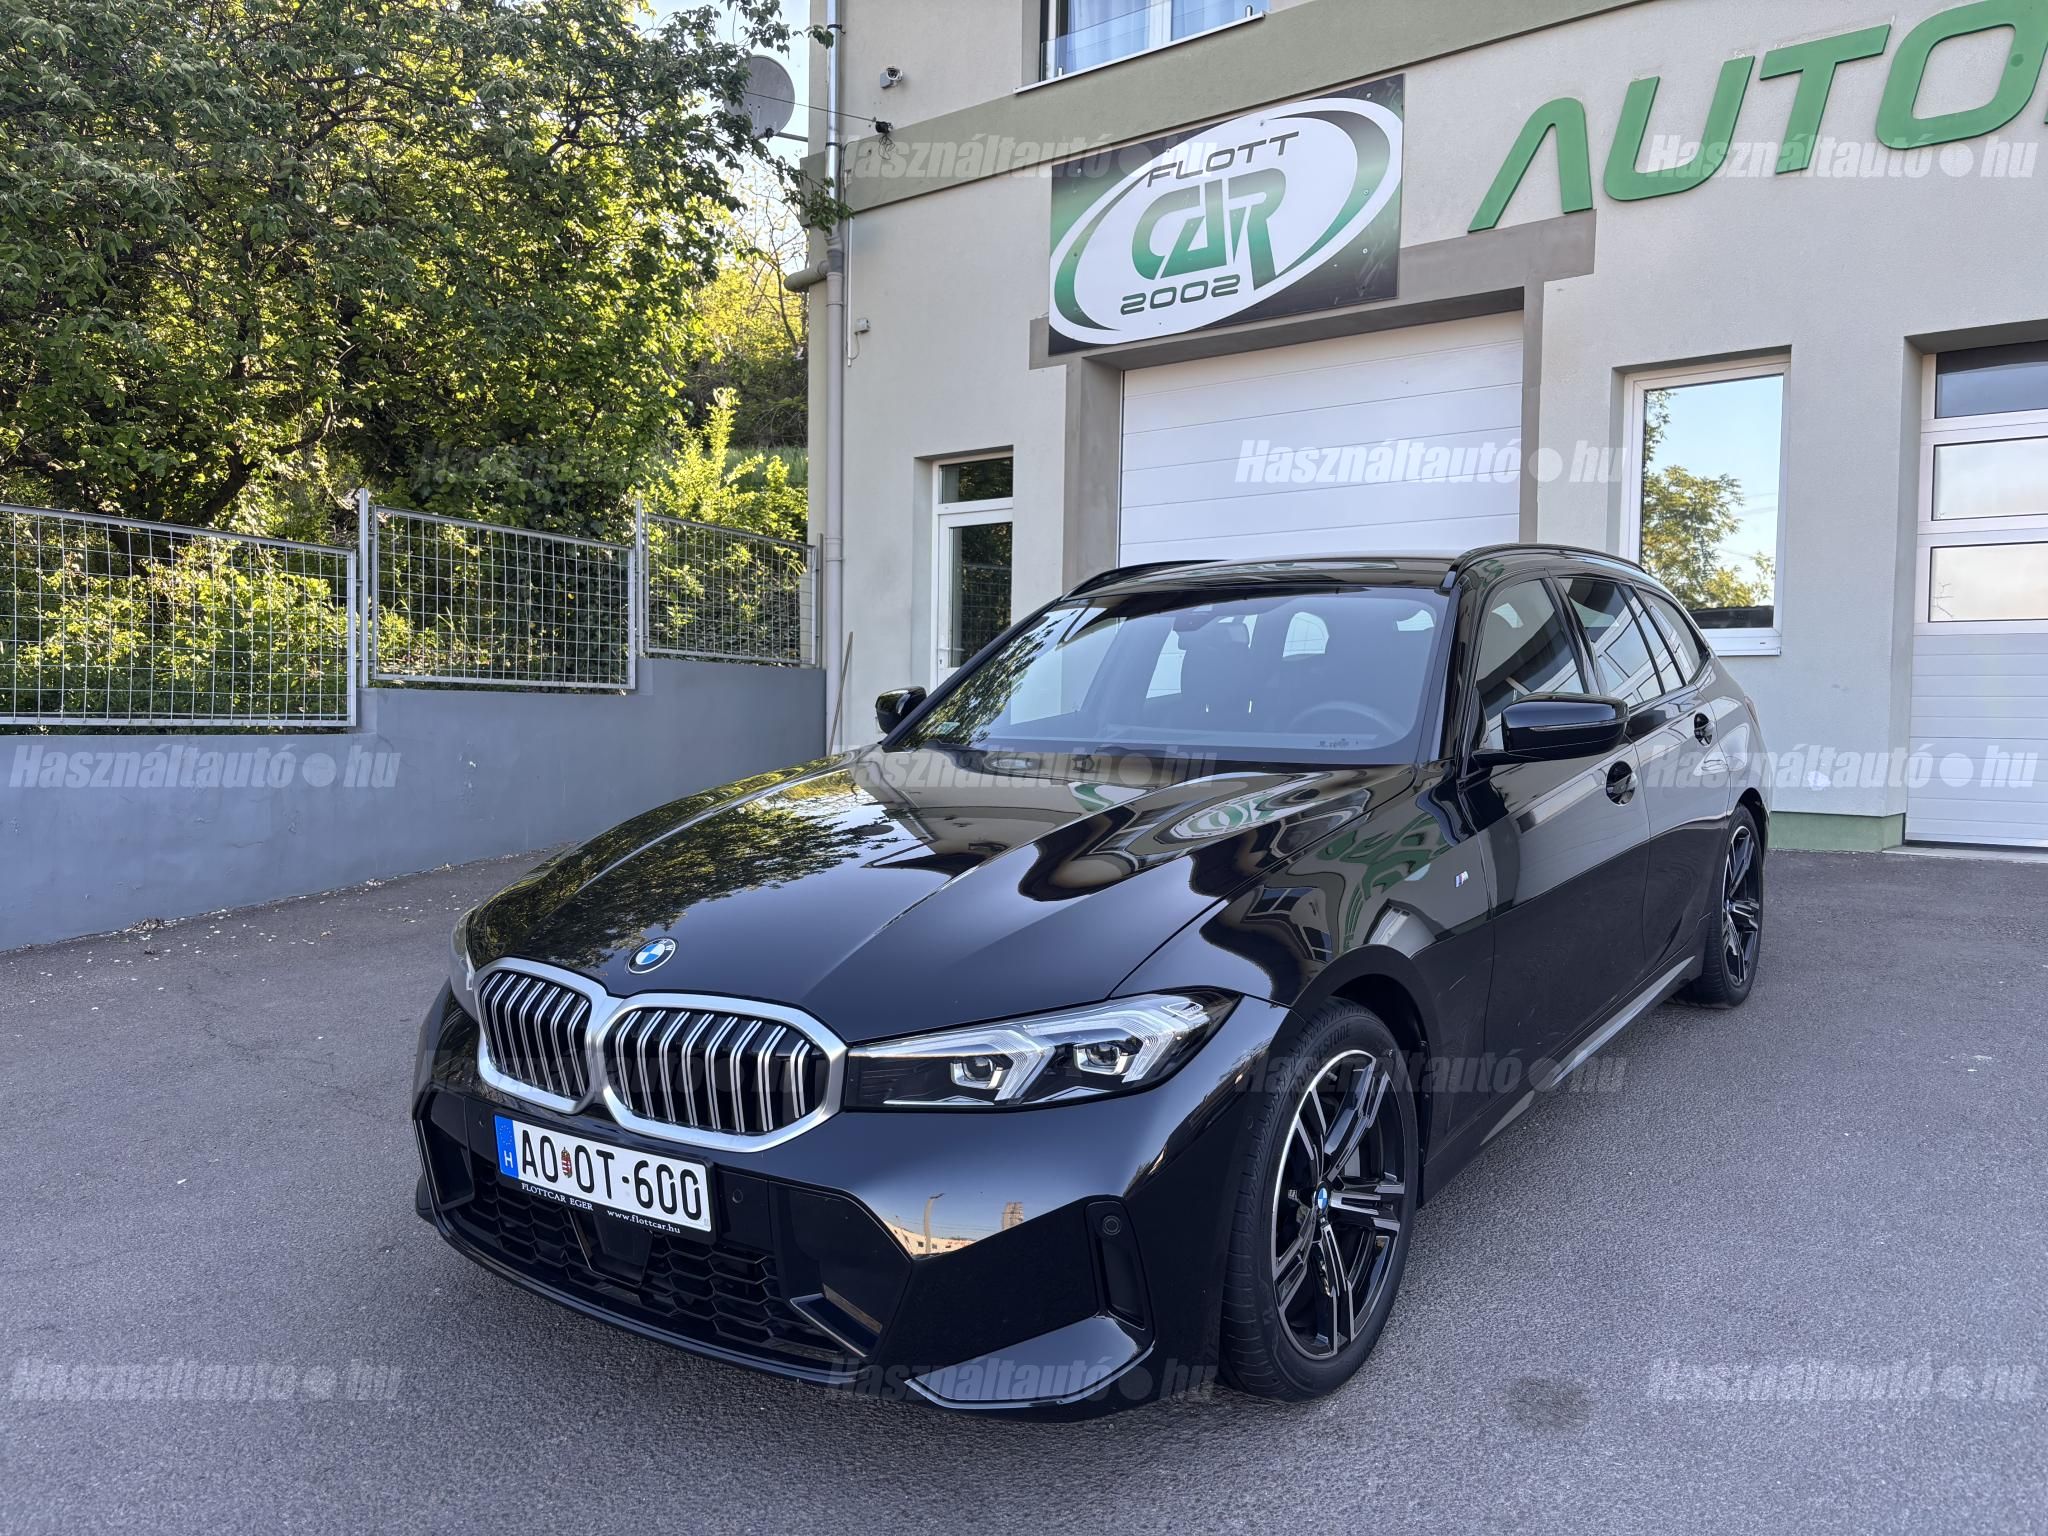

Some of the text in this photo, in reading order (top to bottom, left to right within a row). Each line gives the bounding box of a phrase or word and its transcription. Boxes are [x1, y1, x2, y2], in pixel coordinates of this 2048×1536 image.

[1467, 0, 2048, 233] AUTO
[1147, 131, 1299, 187] FLOTT
[1132, 168, 1286, 291] CAR
[1120, 274, 1240, 315] 2002
[504, 1151, 514, 1169] H
[521, 1182, 681, 1234] FLOTTCAR EGER www.flottcar.hu
